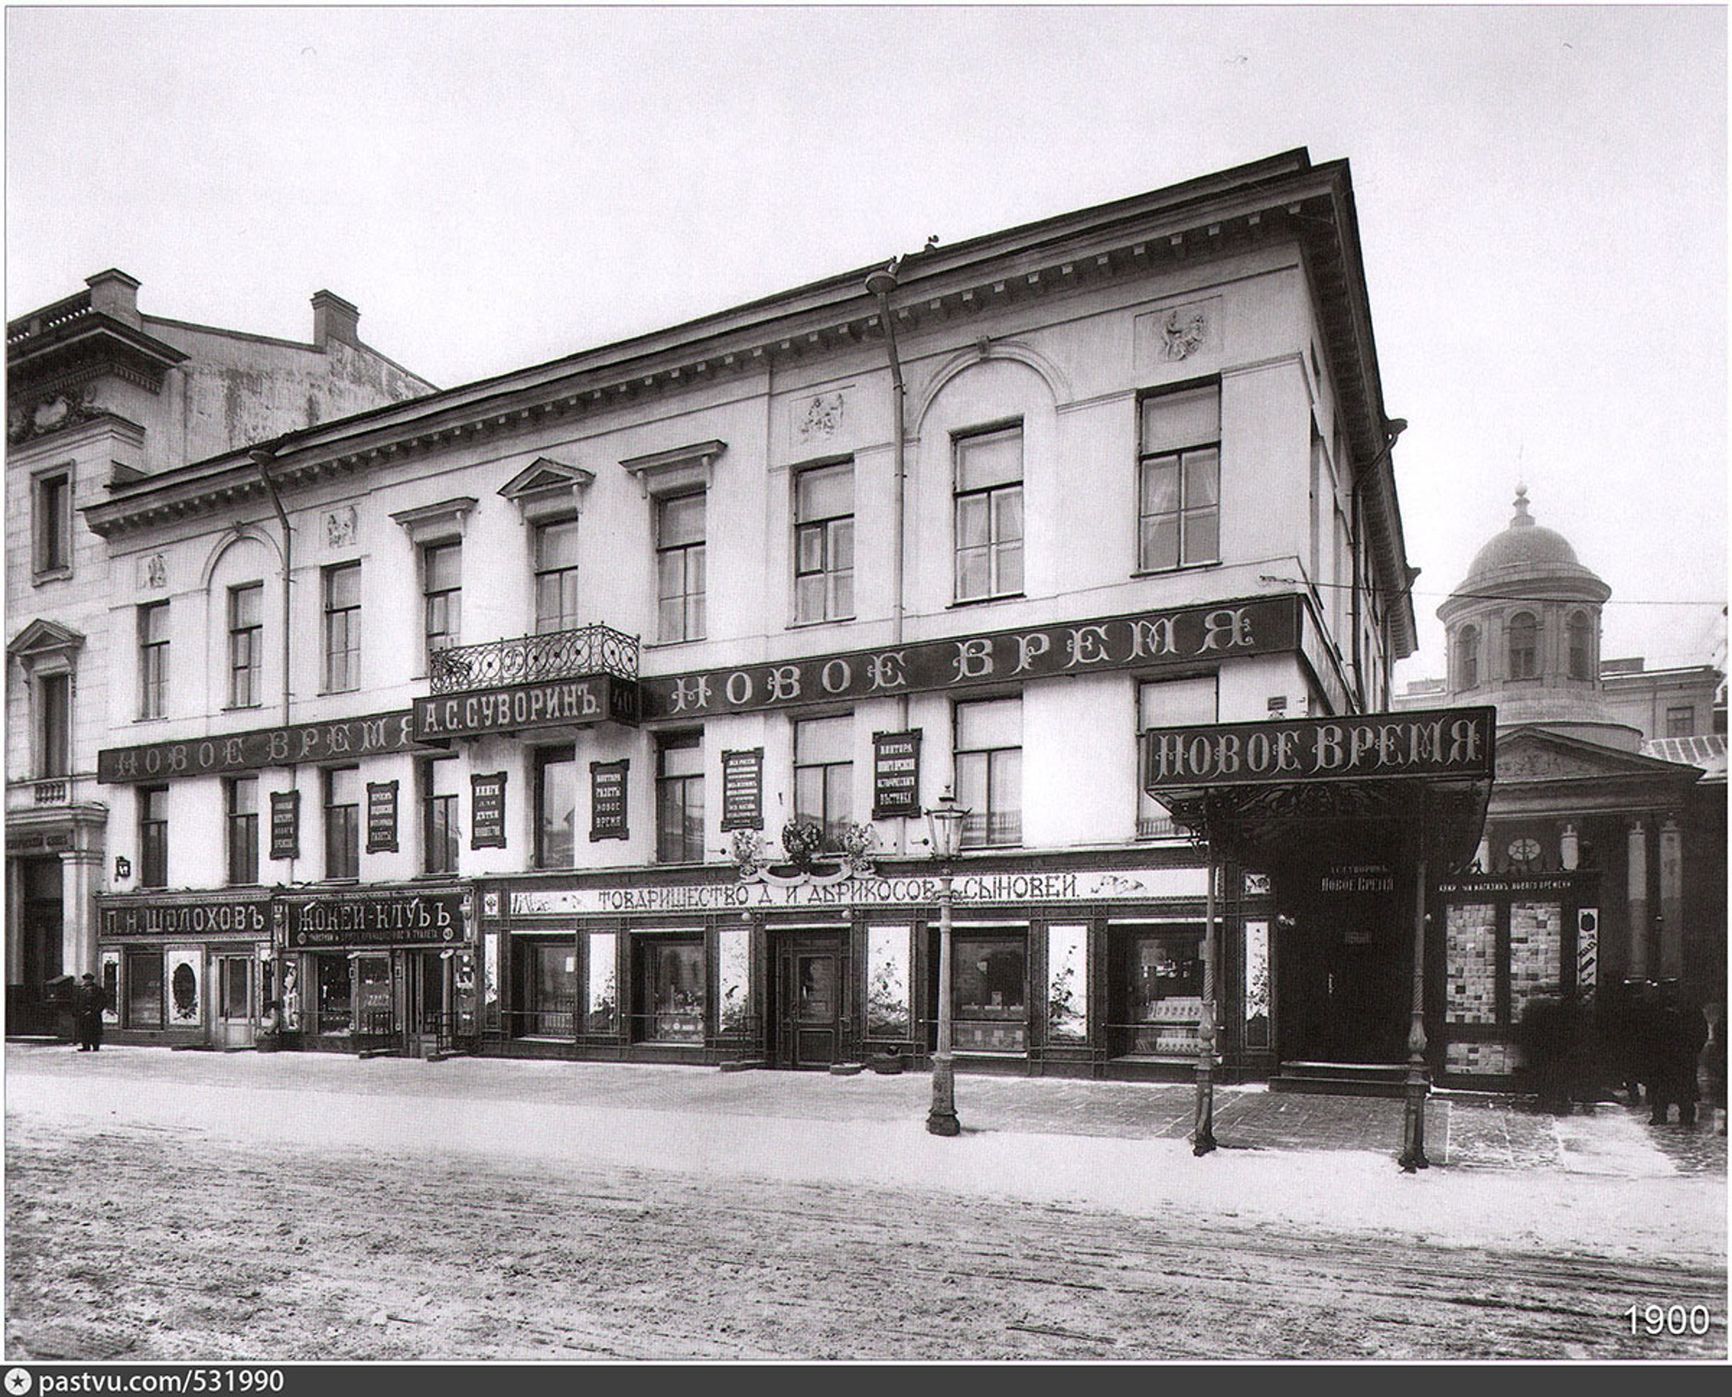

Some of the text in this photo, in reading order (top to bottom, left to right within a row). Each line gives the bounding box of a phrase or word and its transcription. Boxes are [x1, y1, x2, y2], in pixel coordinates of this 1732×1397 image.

[670, 607, 1254, 713] НОВОЕ ВРЕМЯ
[115, 736, 246, 778] НОВОЕ
[1154, 716, 1484, 784] НОВОЕ ВРЕМЯ
[146, 904, 265, 932] ШОЛОХОВЪ
[599, 884, 749, 911] ТОВАРИЩЕСТВО
